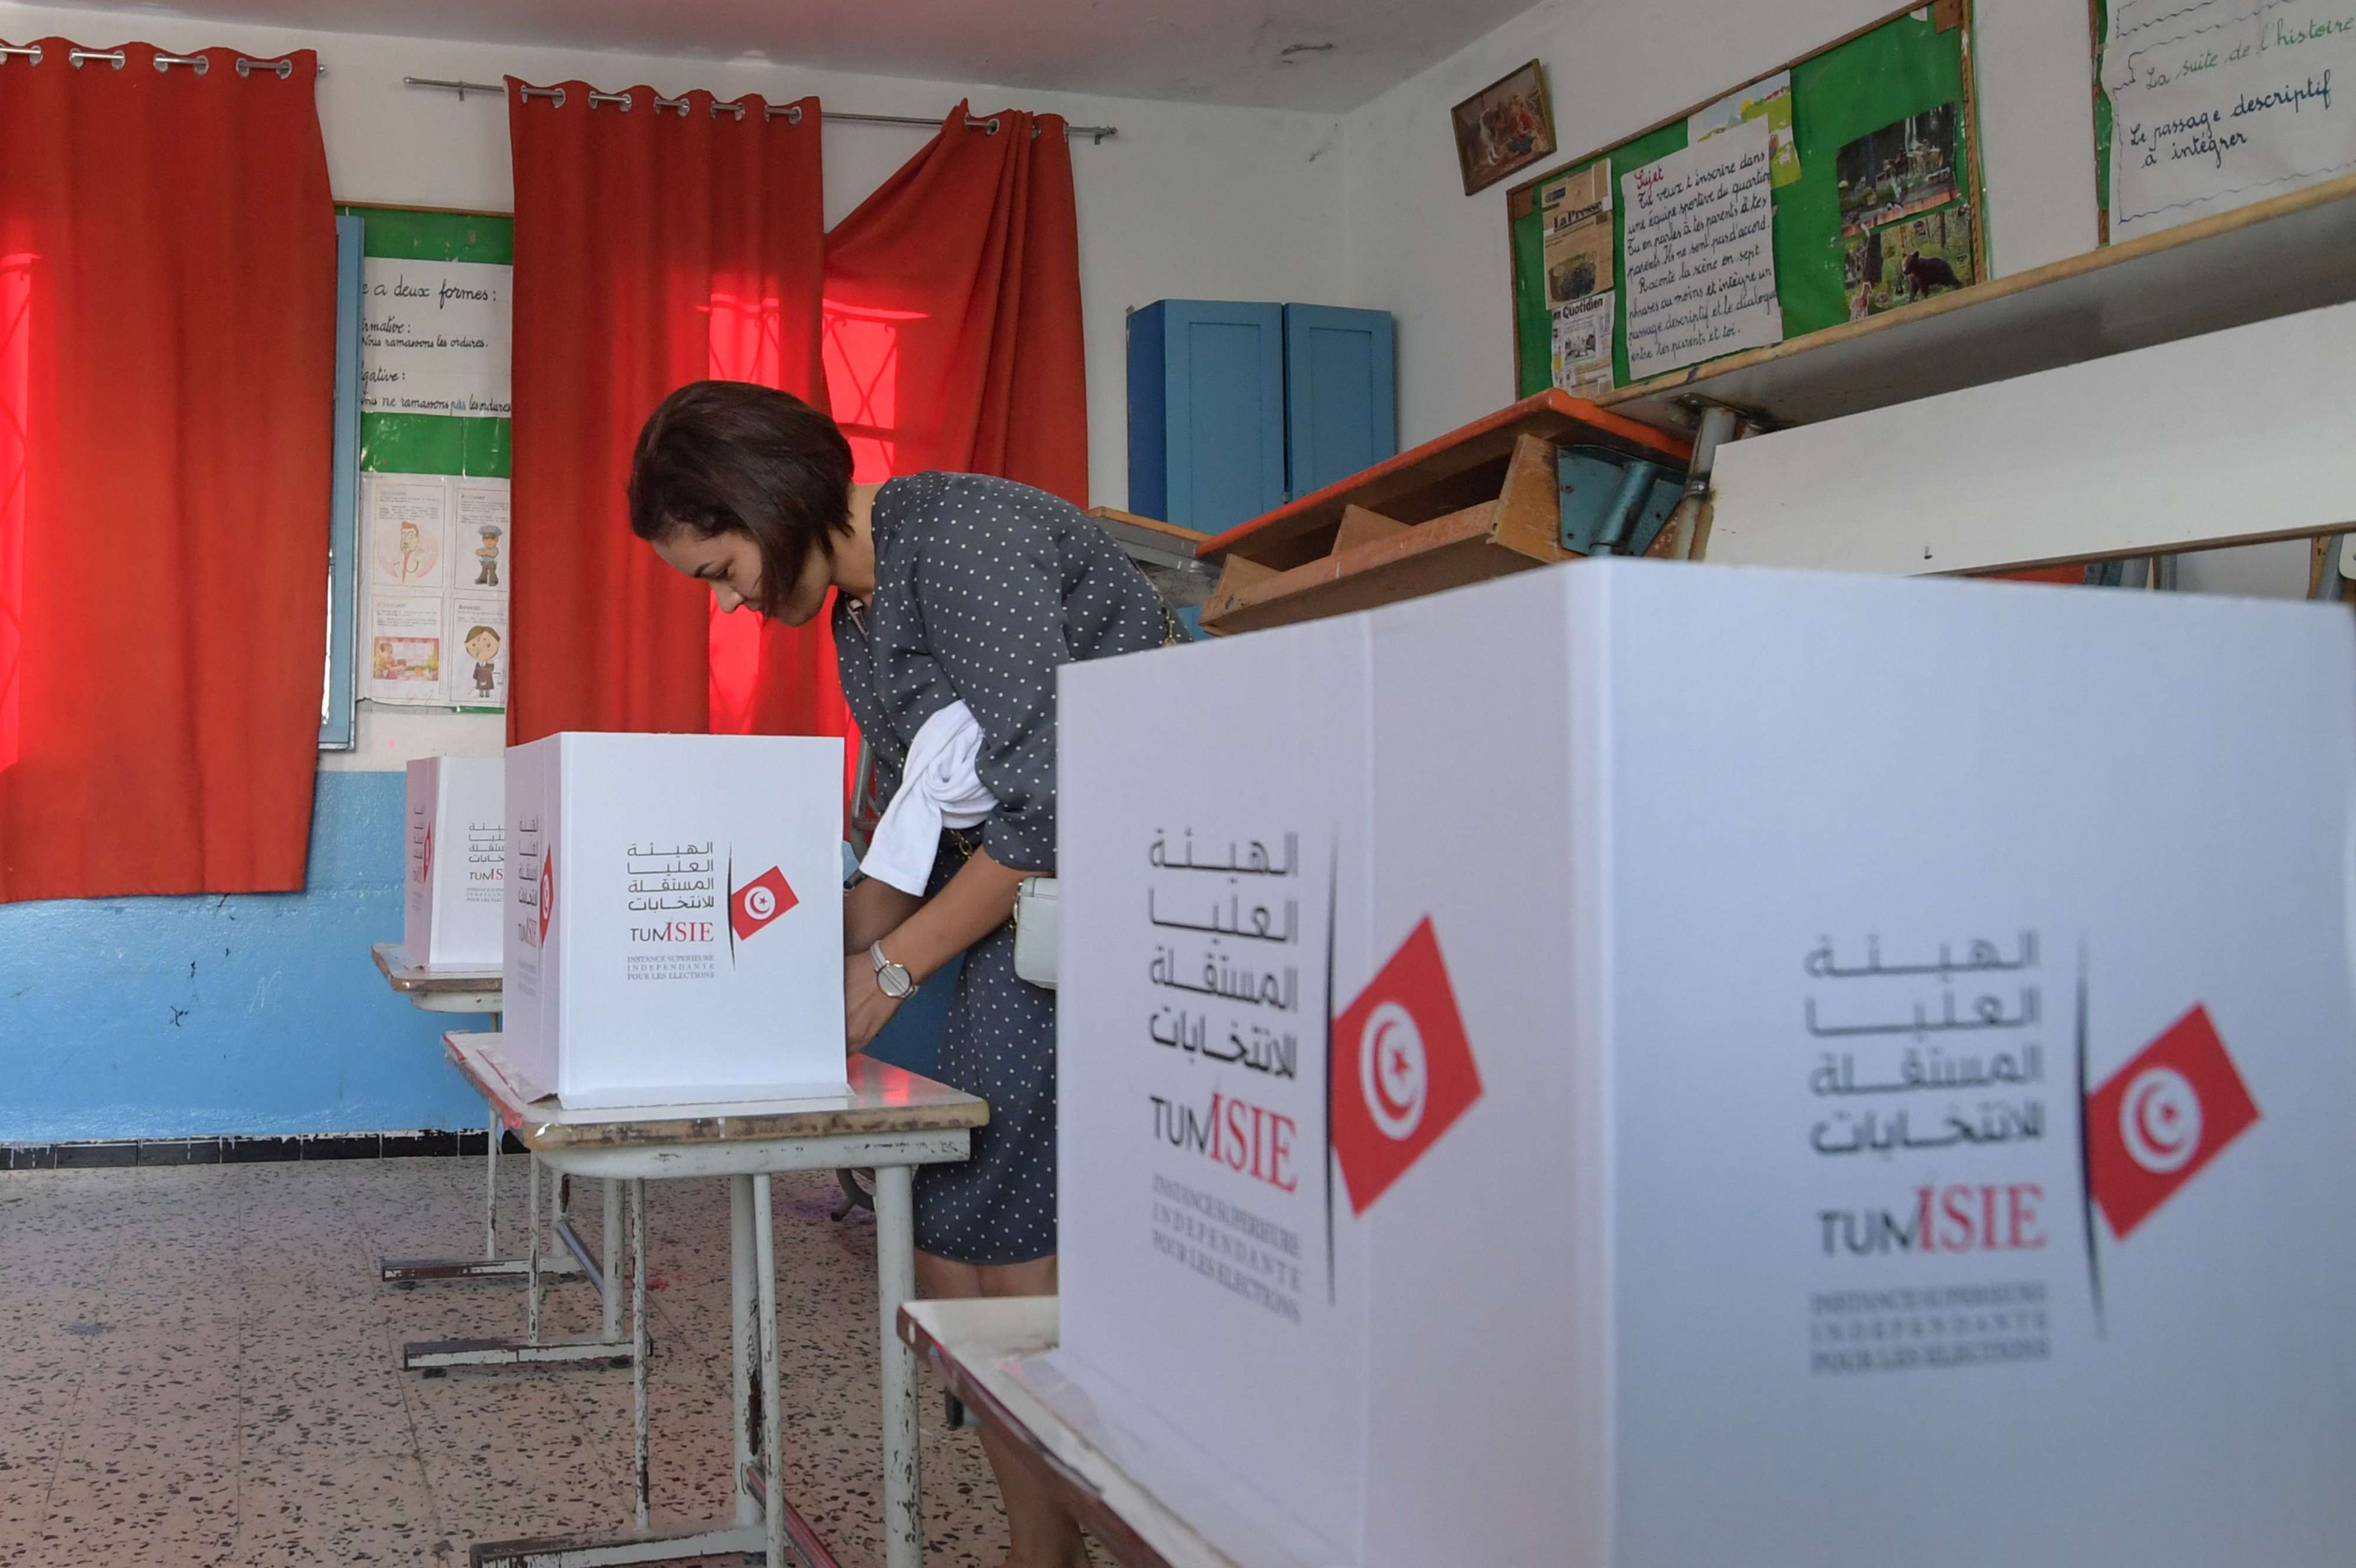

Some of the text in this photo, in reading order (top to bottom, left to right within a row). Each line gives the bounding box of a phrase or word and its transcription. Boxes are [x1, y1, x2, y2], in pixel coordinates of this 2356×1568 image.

[2146, 17, 2354, 90] La suite de l'histoire
[2130, 70, 2331, 152] Le passage descriptif
[2171, 131, 2248, 169] intégrer
[1634, 164, 1664, 196] Sujet
[1656, 183, 1683, 200] veux
[1739, 151, 1765, 170] dans
[1554, 216, 1567, 229] La
[1567, 200, 1603, 223] Presse
[1627, 220, 1646, 234] une
[1649, 206, 1677, 231] équipe
[1679, 190, 1715, 220] sportive
[1717, 185, 1729, 201] du
[1627, 237, 1640, 256] Tu
[1642, 240, 1653, 251] en
[1654, 221, 1682, 258] parles
[1706, 202, 1738, 237] parents
[1676, 249, 1687, 259] ne
[1689, 234, 1710, 256] sont
[374, 283, 387, 296] a
[393, 274, 430, 297] deux
[1639, 270, 1676, 295] Raconte
[1679, 262, 1692, 280] la
[1721, 254, 1735, 266] en
[1737, 244, 1761, 266] sept
[1563, 297, 1604, 319] Quotidien
[1628, 269, 1773, 327] phrases au moins et intègre un
[362, 315, 411, 334] irmative:
[1628, 323, 1663, 347] passage
[1665, 302, 1710, 332] descriptif
[1711, 304, 1723, 317] et
[1723, 295, 1735, 315] le
[385, 338, 434, 348] ramassons
[436, 334, 447, 348] les
[450, 336, 489, 348] ordures.
[1630, 346, 1653, 363] entre
[1671, 329, 1706, 363] parents
[1708, 325, 1722, 342] et
[383, 397, 396, 406] ne
[399, 396, 449, 410] ramassons
[449, 398, 466, 417] pas
[468, 393, 478, 411] les
[627, 842, 713, 858] الهيئة
[627, 859, 714, 875] العليا
[1149, 829, 1298, 882] الهيئة
[469, 868, 503, 881] TUNIS
[628, 877, 714, 893] المستقلة
[628, 895, 714, 912] للانتخابات
[1150, 887, 1298, 944] العليا
[630, 920, 714, 942] TUNISIE
[627, 963, 715, 972] INDEPENDANTE
[669, 971, 715, 980] ELECTIONS
[1151, 944, 1298, 1012] المستقلة
[1806, 984, 2040, 1041] العليا
[1150, 1006, 1297, 1081] للانتخابات
[1809, 1044, 2042, 1095] المستقلة
[1150, 1092, 1297, 1193] TUNISIE
[1818, 1183, 2047, 1255] TUNISIE
